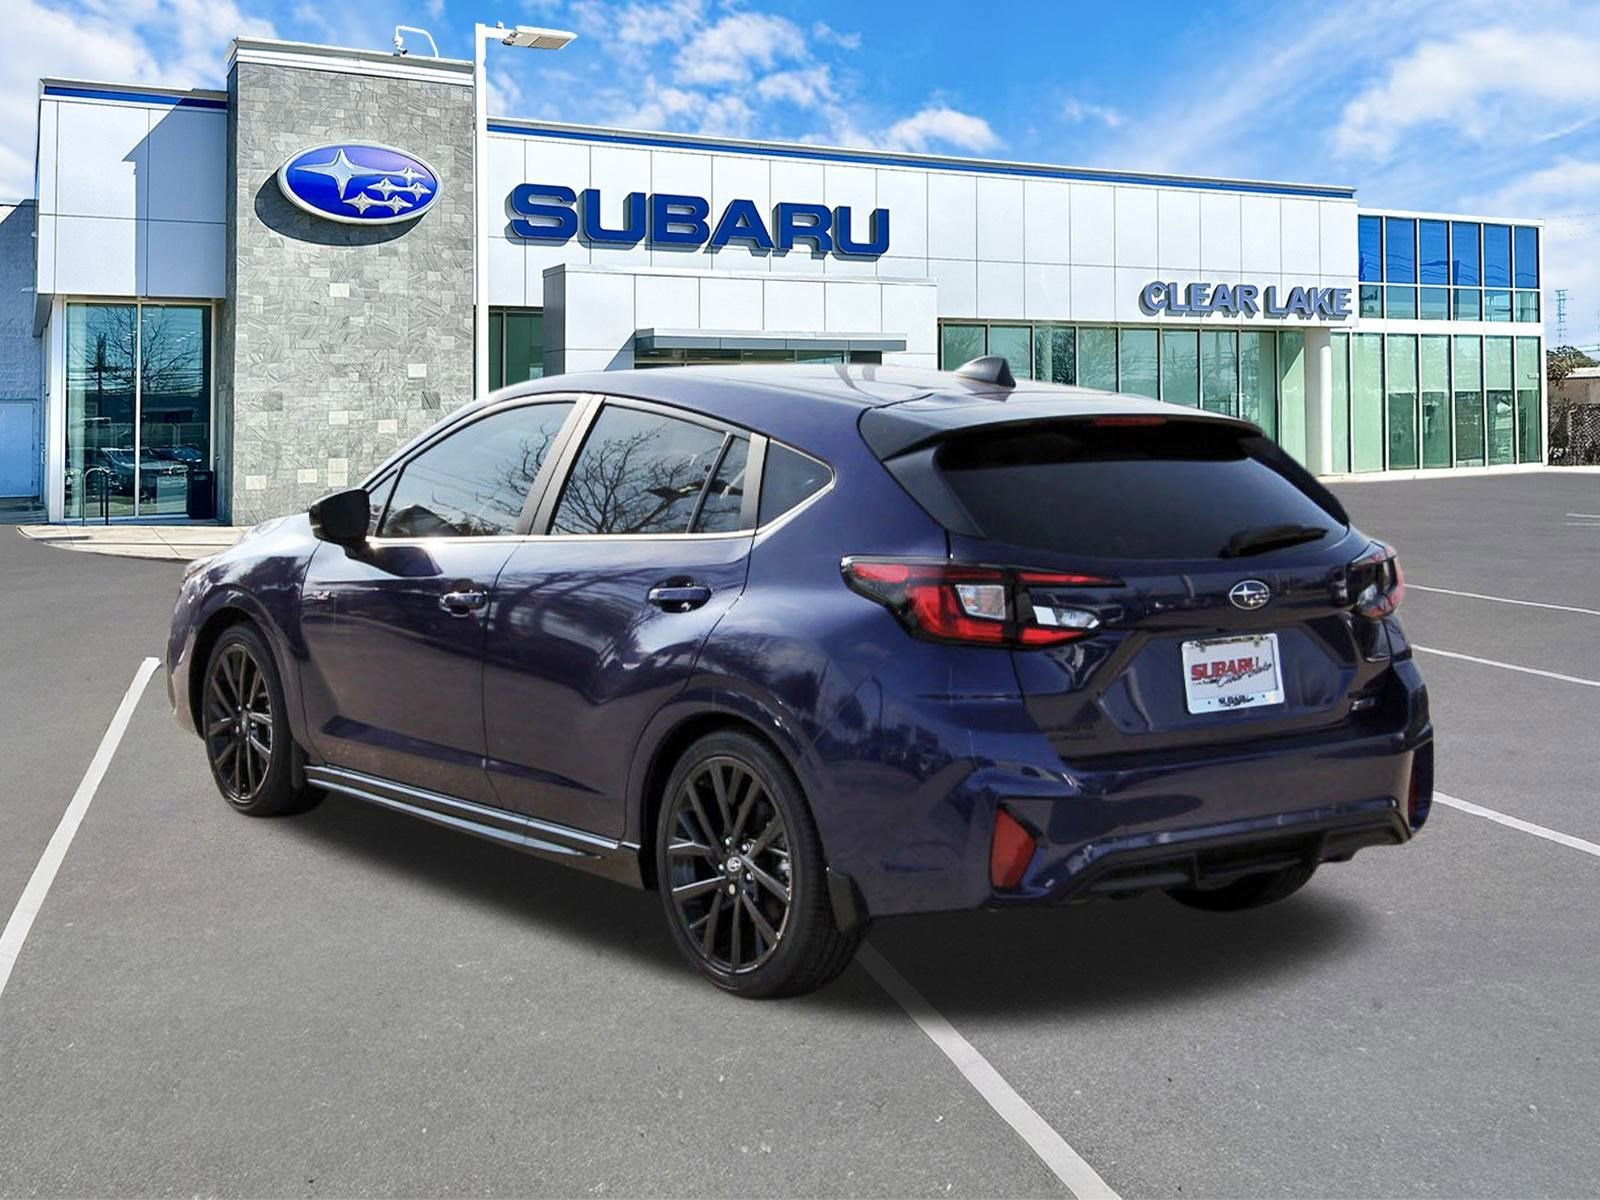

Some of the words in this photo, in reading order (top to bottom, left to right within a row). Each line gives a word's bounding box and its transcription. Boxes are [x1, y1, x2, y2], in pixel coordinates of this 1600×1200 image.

[506, 183, 890, 260] SUBARU
[1139, 281, 1261, 317] CLEAR
[1264, 286, 1353, 320] LAKE
[1191, 657, 1259, 680] SUBARU
